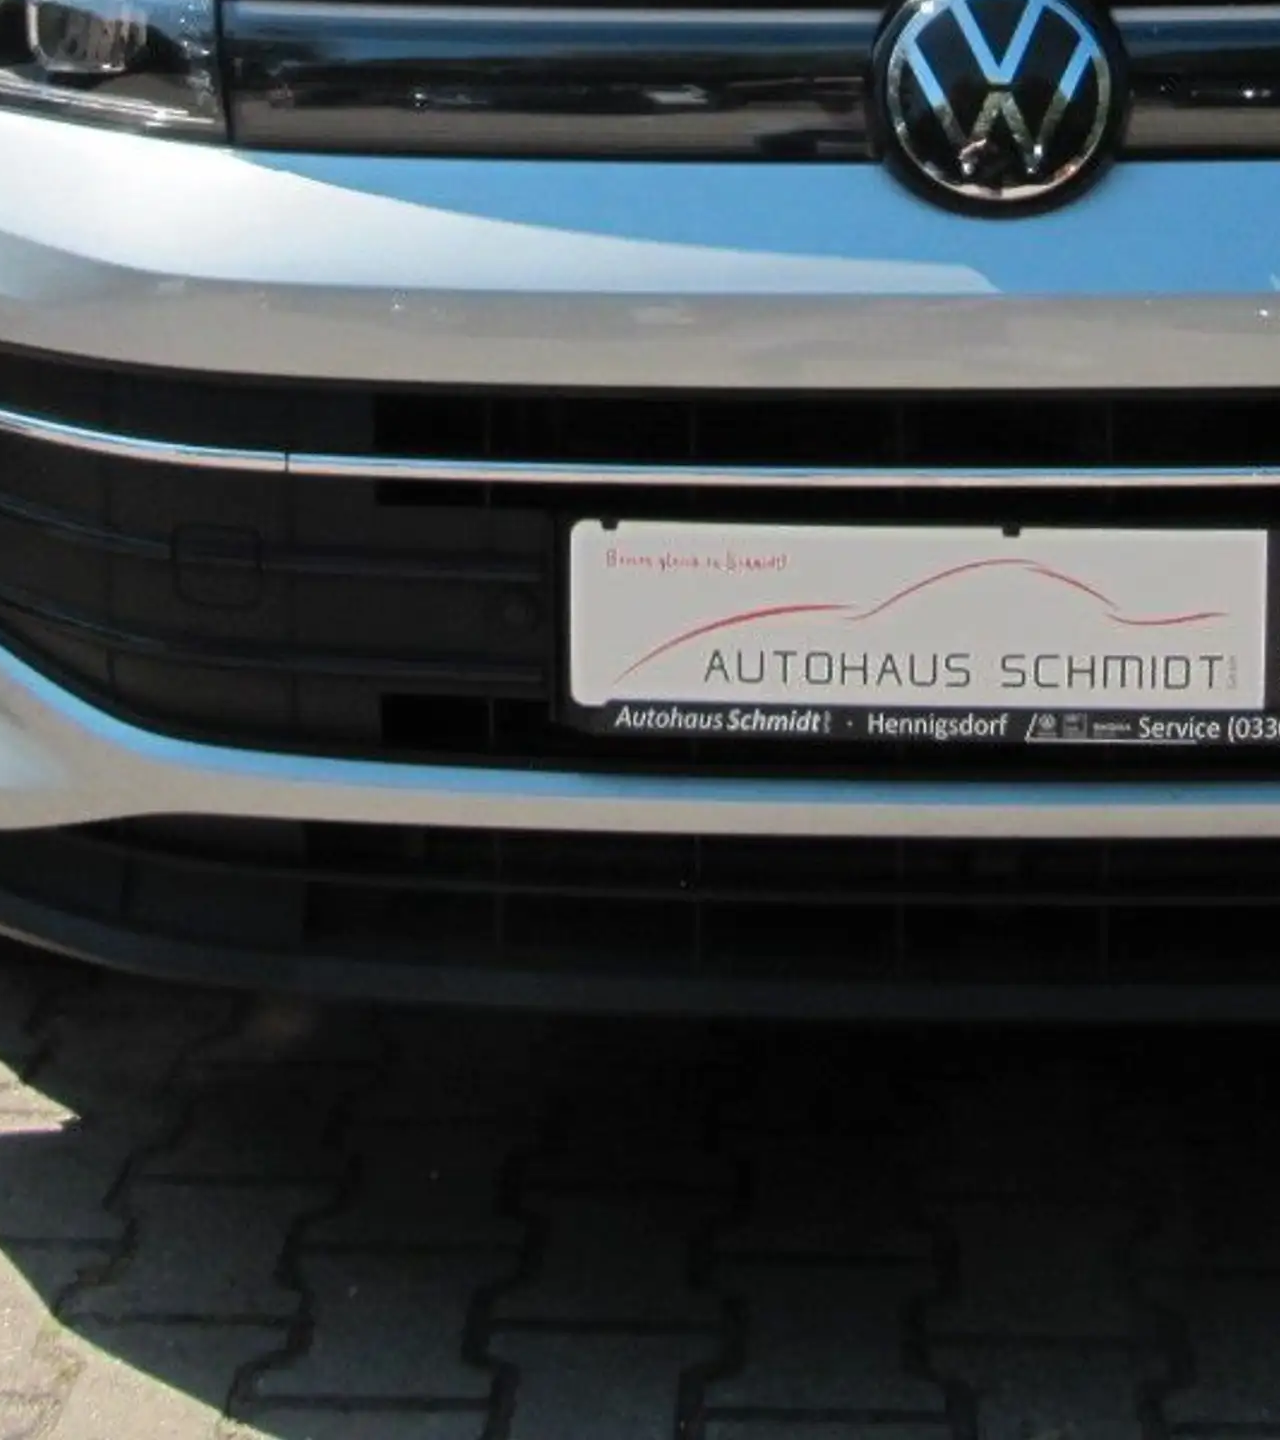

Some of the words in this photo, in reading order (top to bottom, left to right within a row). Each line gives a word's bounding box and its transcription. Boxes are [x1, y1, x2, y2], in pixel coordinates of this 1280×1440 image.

[704, 650, 971, 688] AUTOHAUS
[1001, 653, 1224, 691] SCHMIDT
[615, 706, 723, 731] Autohaus
[727, 708, 821, 734] Schmidt
[867, 712, 1008, 741] Hennigsdorf
[1138, 714, 1220, 740] Service
